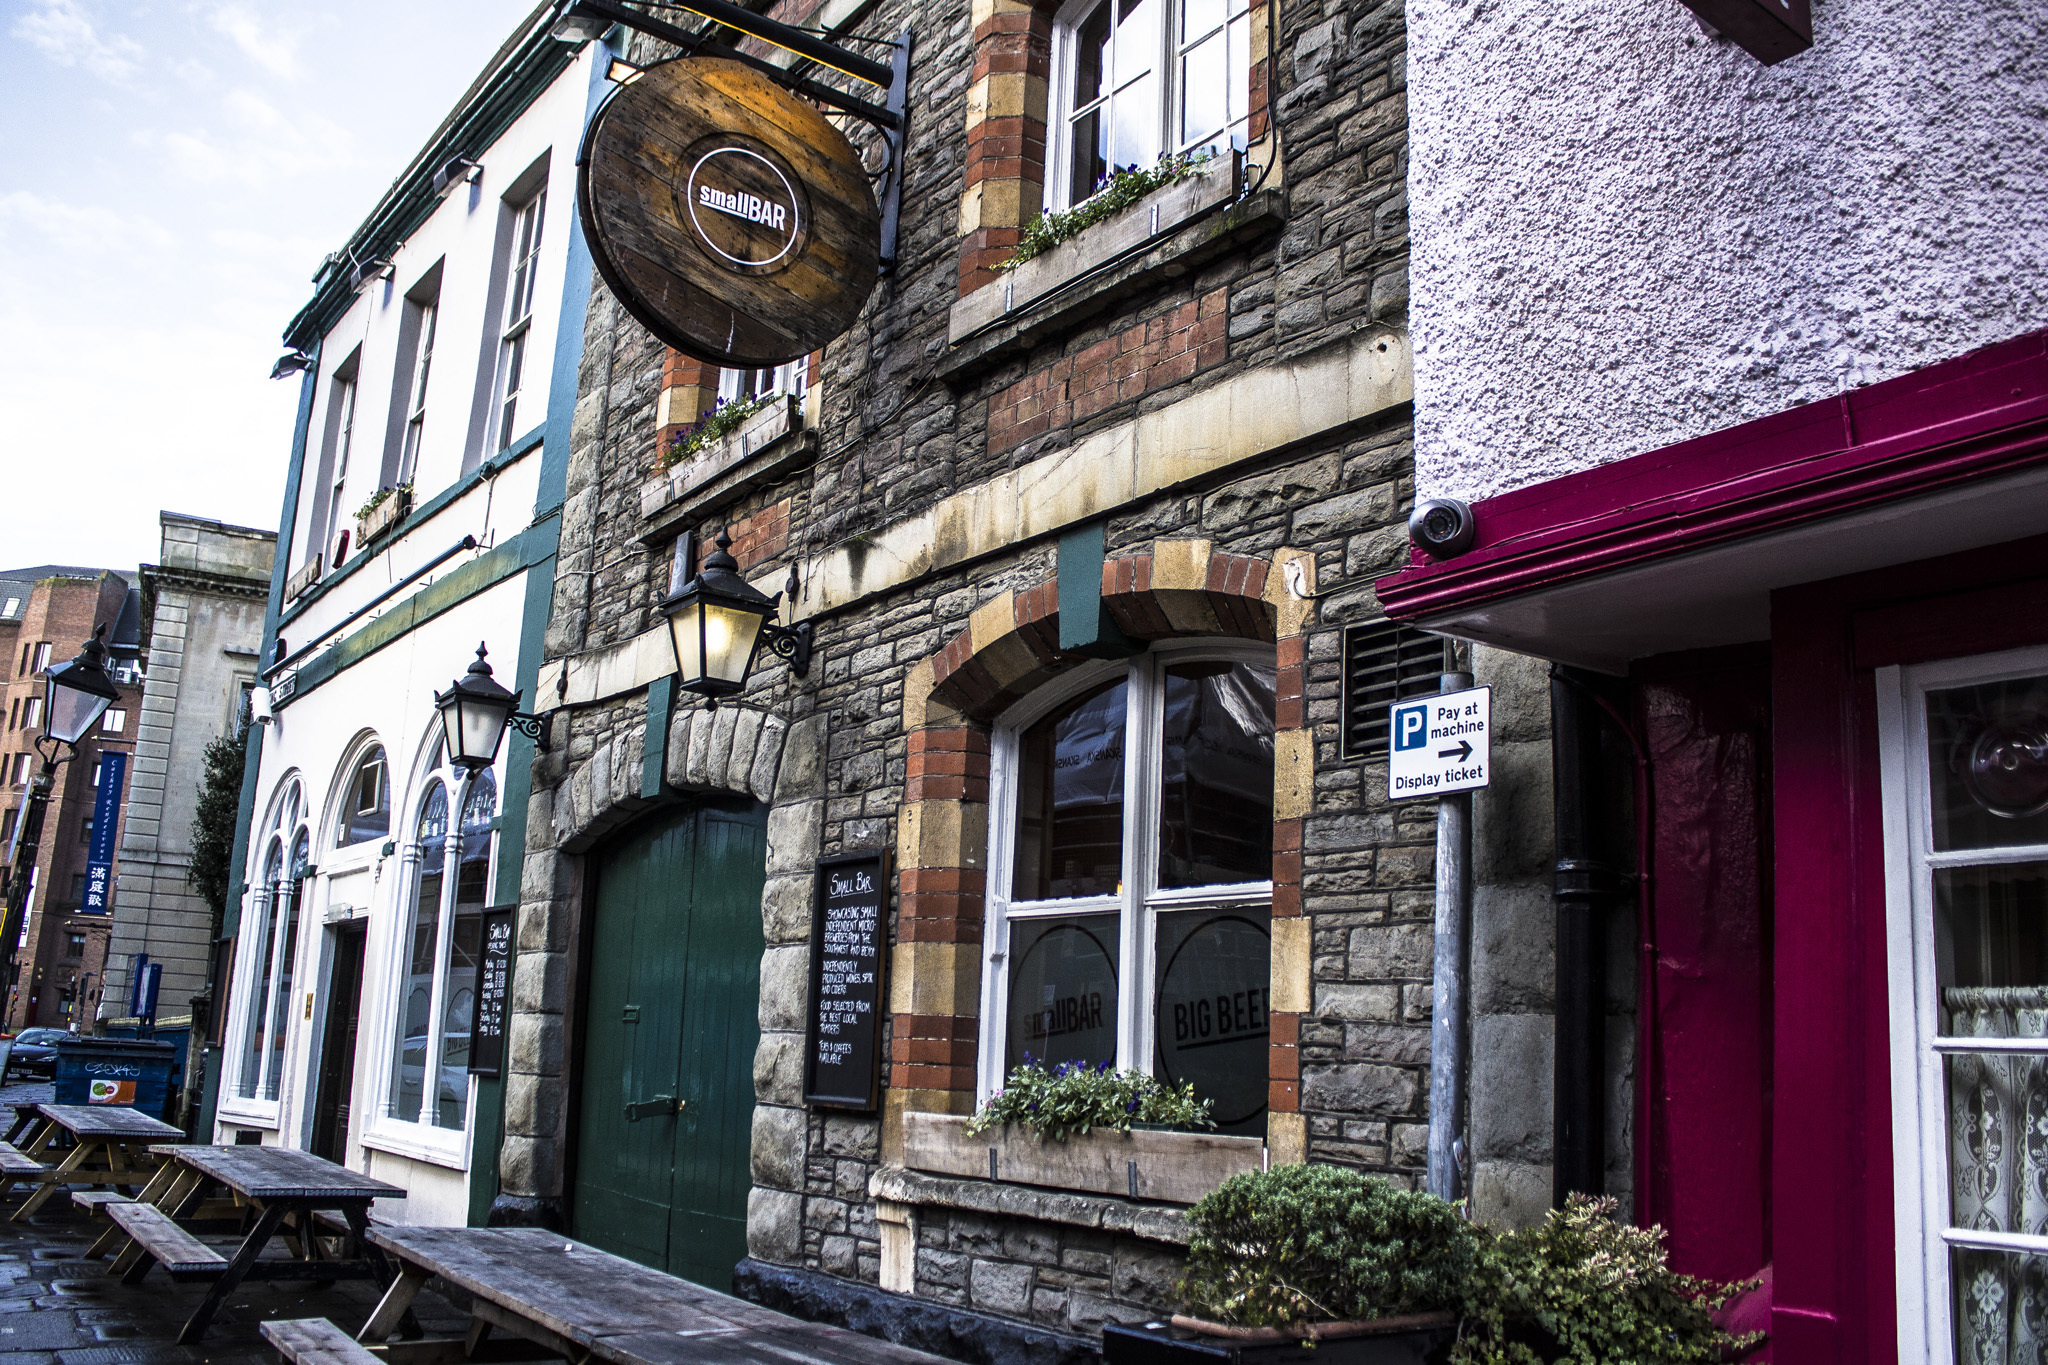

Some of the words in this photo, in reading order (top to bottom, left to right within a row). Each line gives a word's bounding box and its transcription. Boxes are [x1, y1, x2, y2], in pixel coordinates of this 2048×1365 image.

[700, 185, 786, 231] smallBAR
[1437, 707, 1460, 721] Pay
[1464, 702, 1478, 716] at
[1402, 711, 1423, 747] P
[1431, 720, 1484, 739] machine
[1396, 773, 1440, 790] Display
[1445, 765, 1483, 782] ticket
[828, 906, 860, 920] SHOWCASING
[825, 920, 857, 932] INDEPENDENT
[861, 932, 871, 944] THE
[820, 999, 832, 1012] FOOD
[1024, 992, 1103, 1034] smallBAR
[1174, 999, 1211, 1041] BIG
